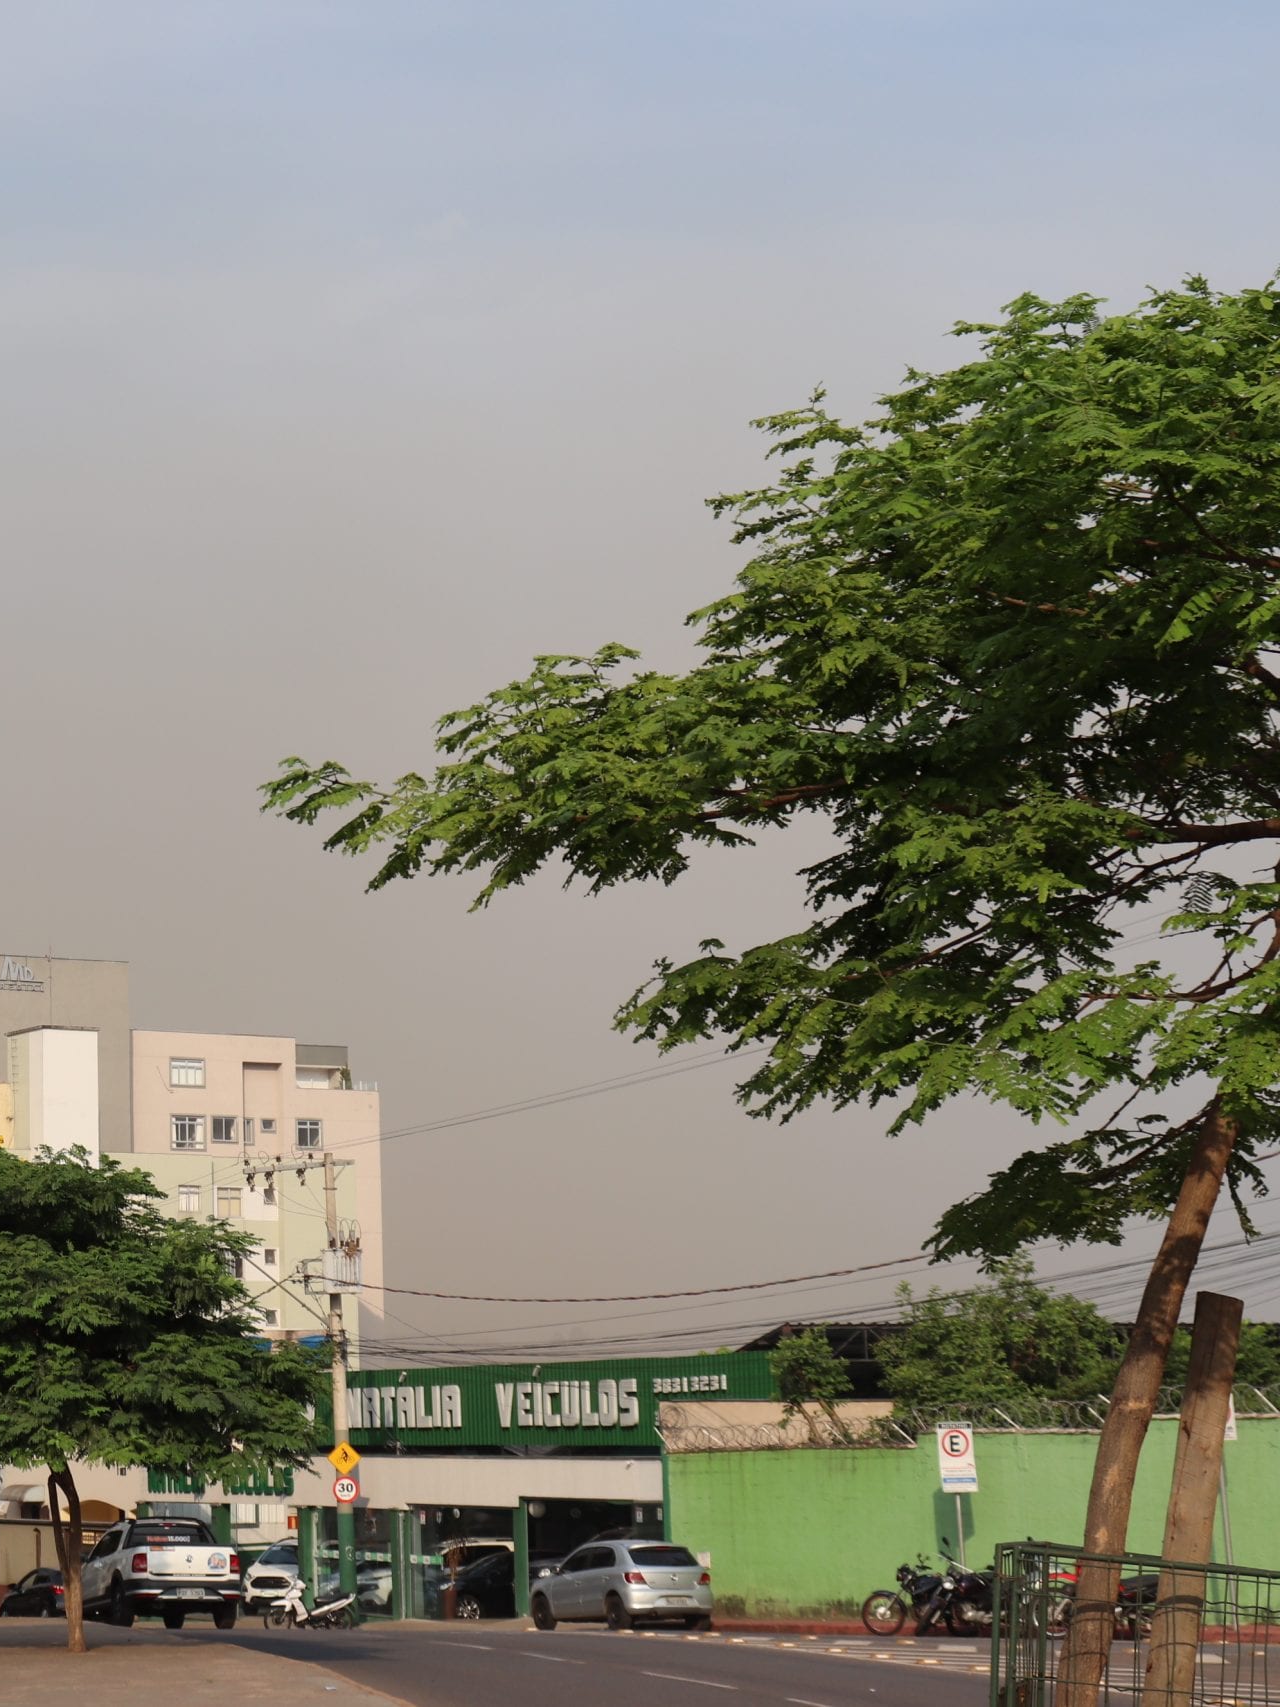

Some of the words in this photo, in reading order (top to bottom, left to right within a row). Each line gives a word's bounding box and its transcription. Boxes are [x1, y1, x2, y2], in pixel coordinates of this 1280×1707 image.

[346, 1384, 462, 1429] NATALIA
[495, 1378, 640, 1428] VEICULOS
[949, 1435, 961, 1453] E
[338, 1482, 354, 1493] 30
